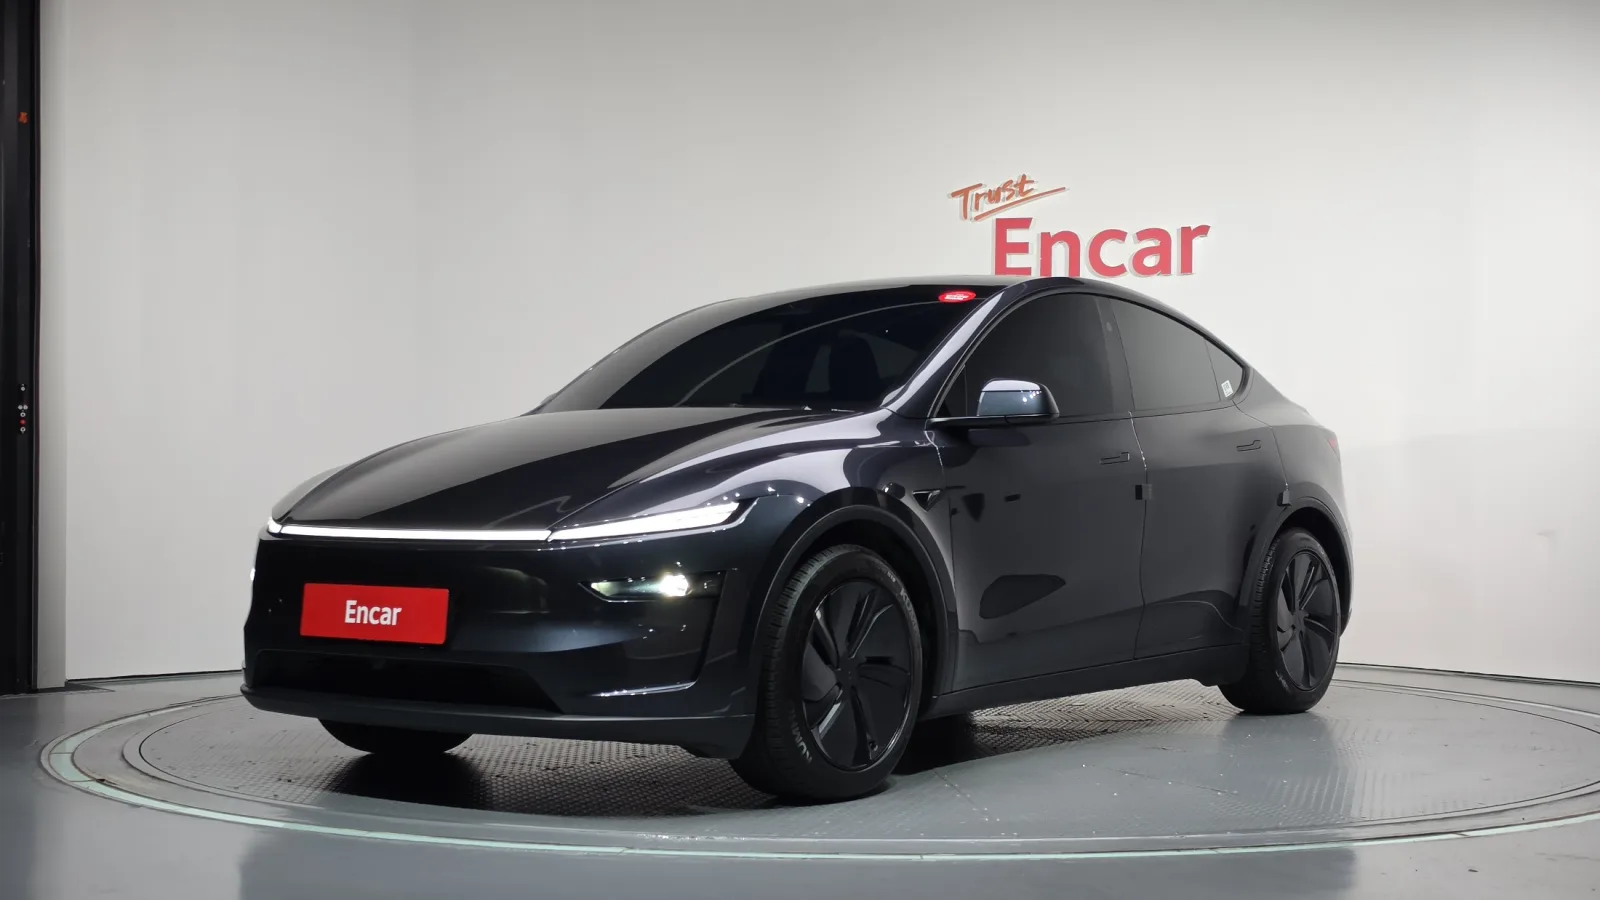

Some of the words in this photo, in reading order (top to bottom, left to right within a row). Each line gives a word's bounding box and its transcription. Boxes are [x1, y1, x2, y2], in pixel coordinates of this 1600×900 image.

[950, 173, 1035, 220] Trust
[993, 217, 1211, 278] Encar
[344, 599, 402, 626] Encar
